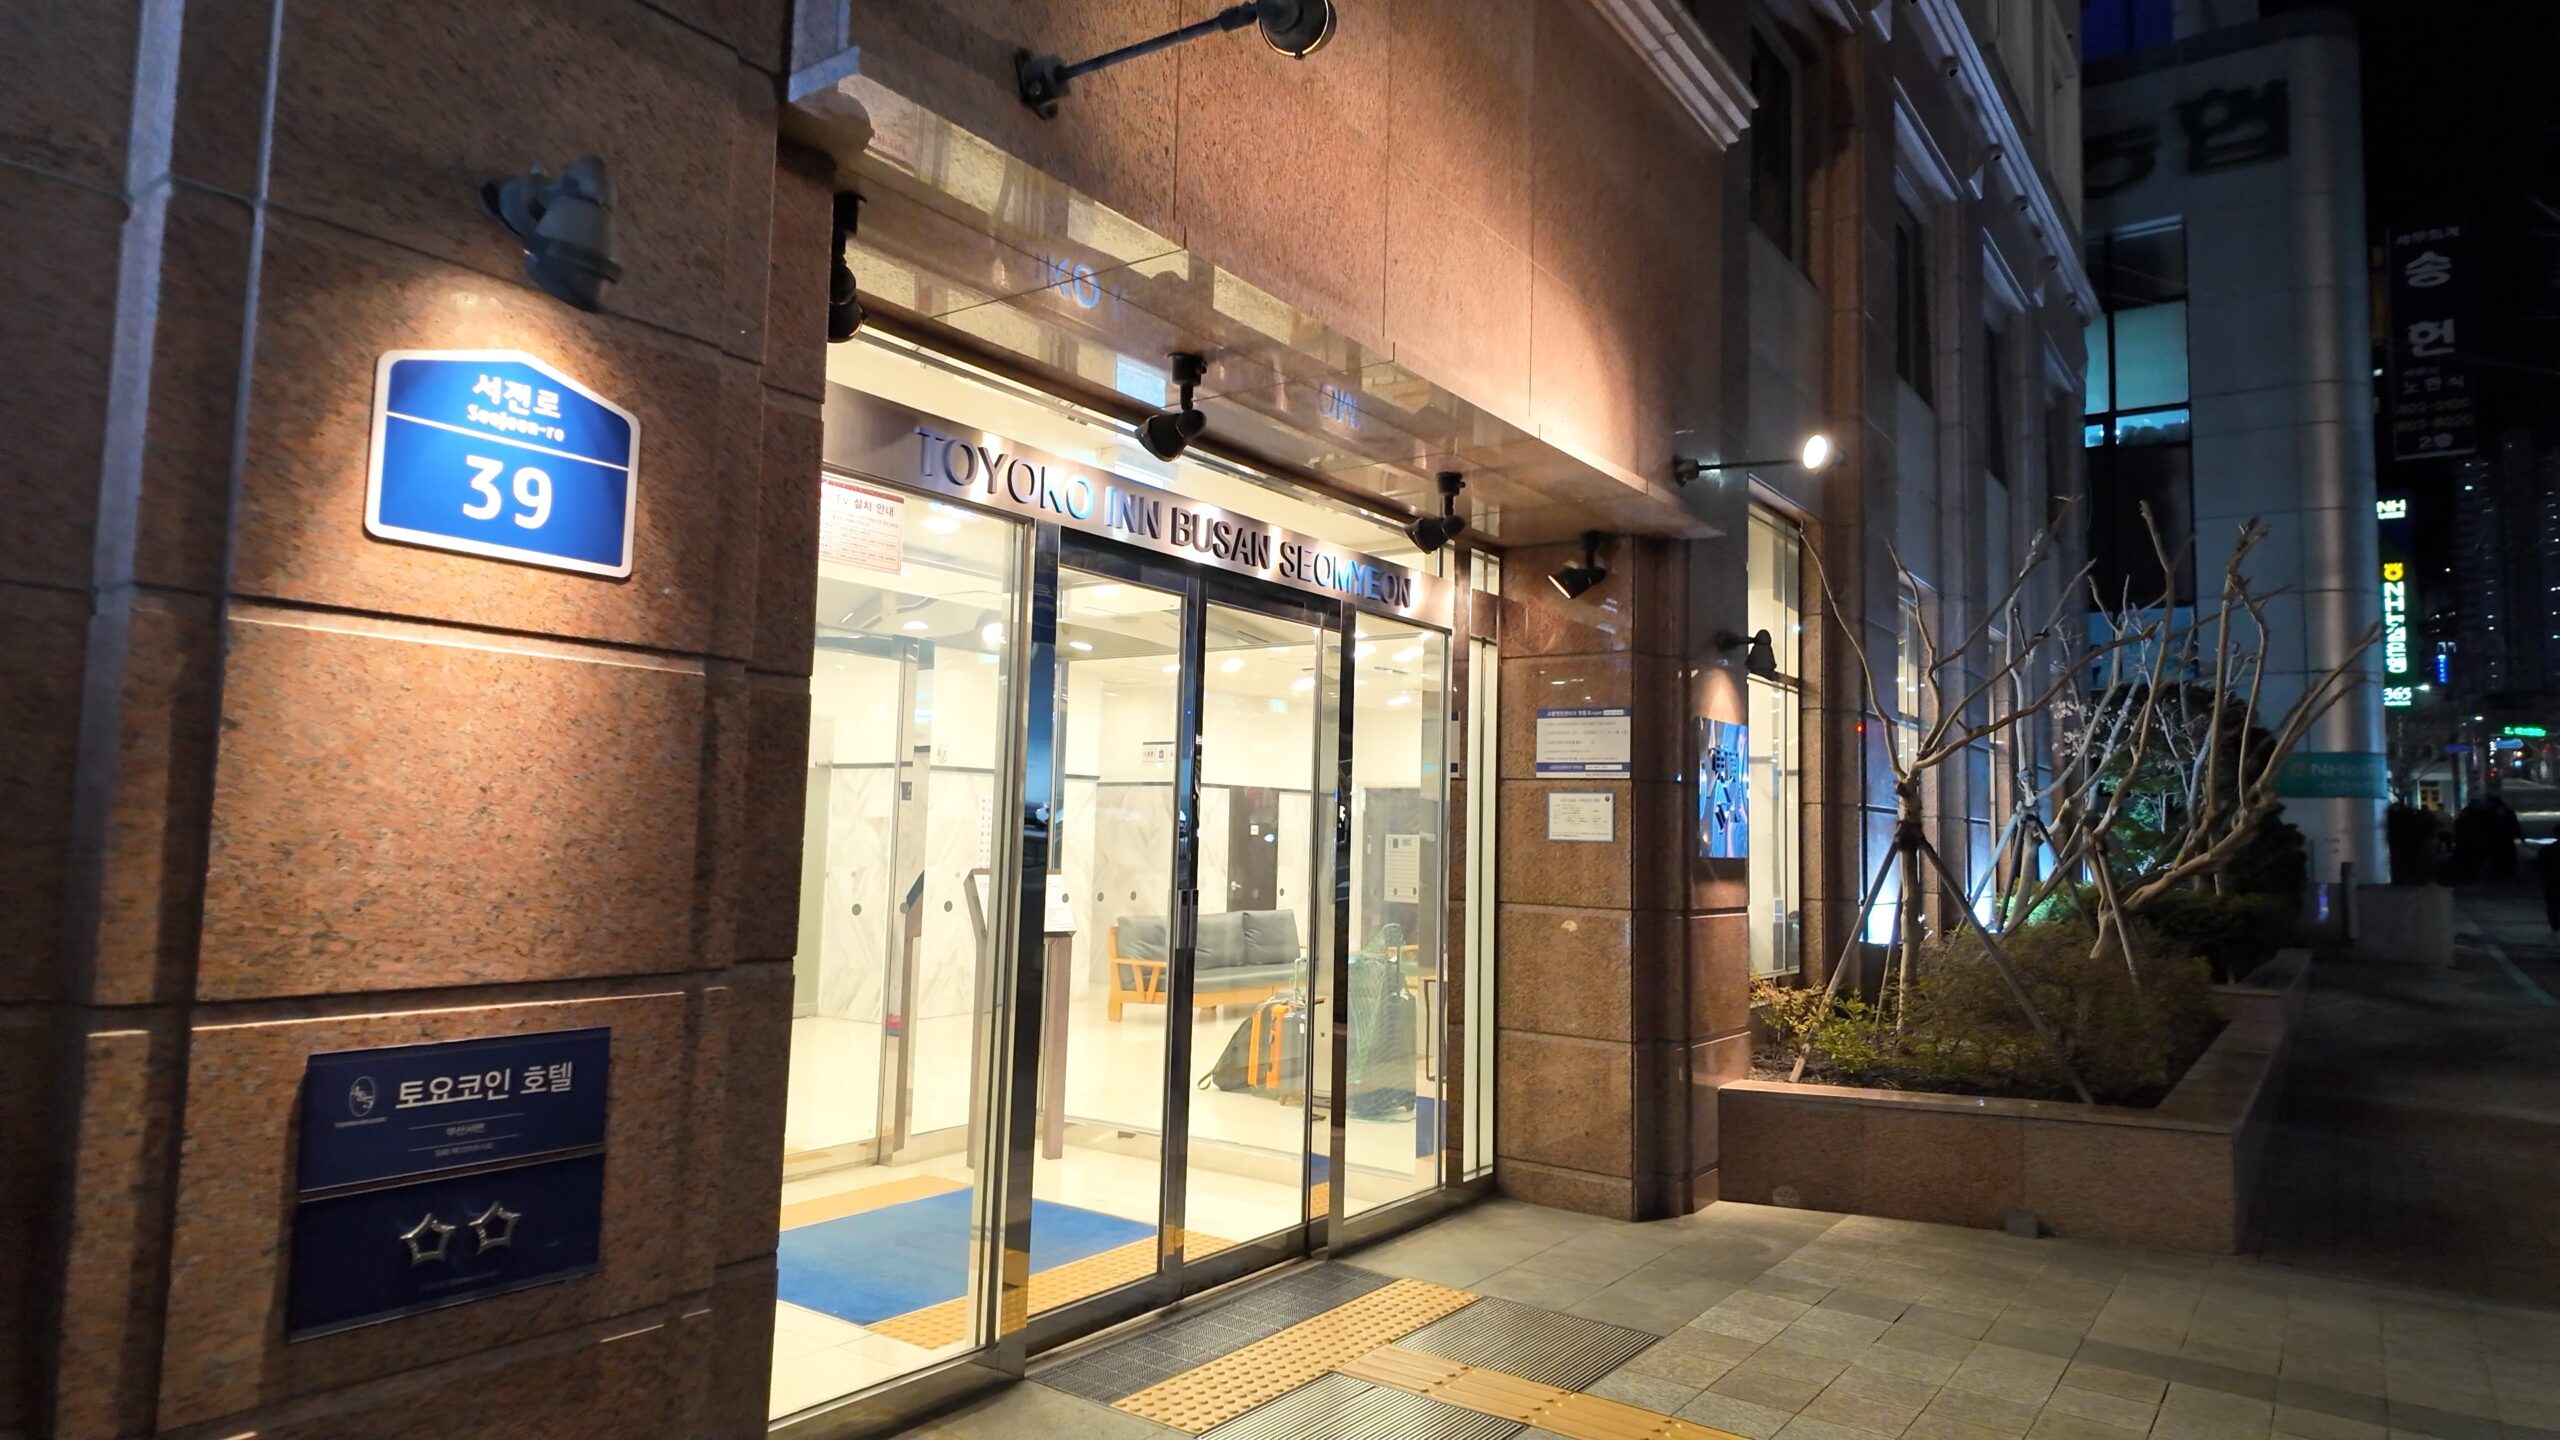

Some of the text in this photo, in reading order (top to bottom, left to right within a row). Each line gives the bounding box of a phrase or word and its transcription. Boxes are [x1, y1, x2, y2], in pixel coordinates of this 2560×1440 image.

[472, 374, 561, 419] 서전로
[462, 454, 553, 530] 39
[854, 499, 872, 512] 설치
[876, 503, 894, 517] 안내
[2376, 499, 2406, 513] NH
[914, 426, 1412, 608] TOYOKO INN BUSAN SEOMYEON
[2384, 687, 2412, 701] 365
[395, 1061, 573, 1110] 토요코인 호텔
